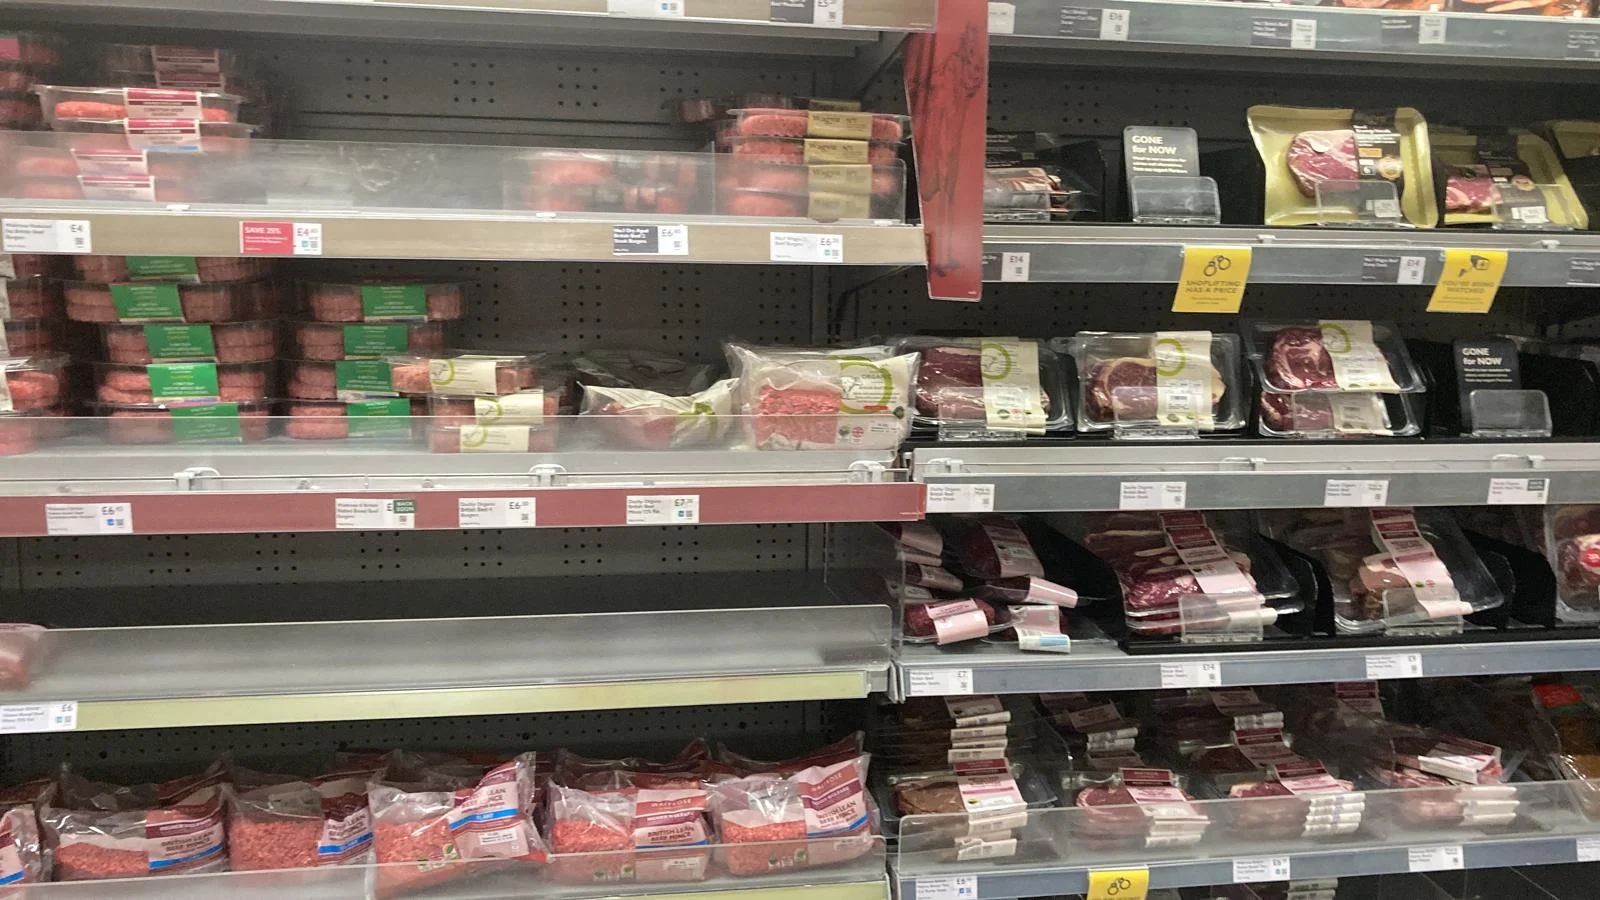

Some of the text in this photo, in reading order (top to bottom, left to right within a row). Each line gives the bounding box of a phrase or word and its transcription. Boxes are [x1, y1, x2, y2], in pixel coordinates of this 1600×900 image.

[1132, 135, 1164, 145] GONE
[1132, 145, 1177, 155] for NOW
[1186, 280, 1242, 288] SHOPLIFTING
[1462, 347, 1489, 356] GONE
[1463, 357, 1502, 365] for NOW
[650, 798, 692, 808] WAITROSE
[839, 799, 857, 812] LEAN
[647, 824, 695, 838] BRITISH LEAN
